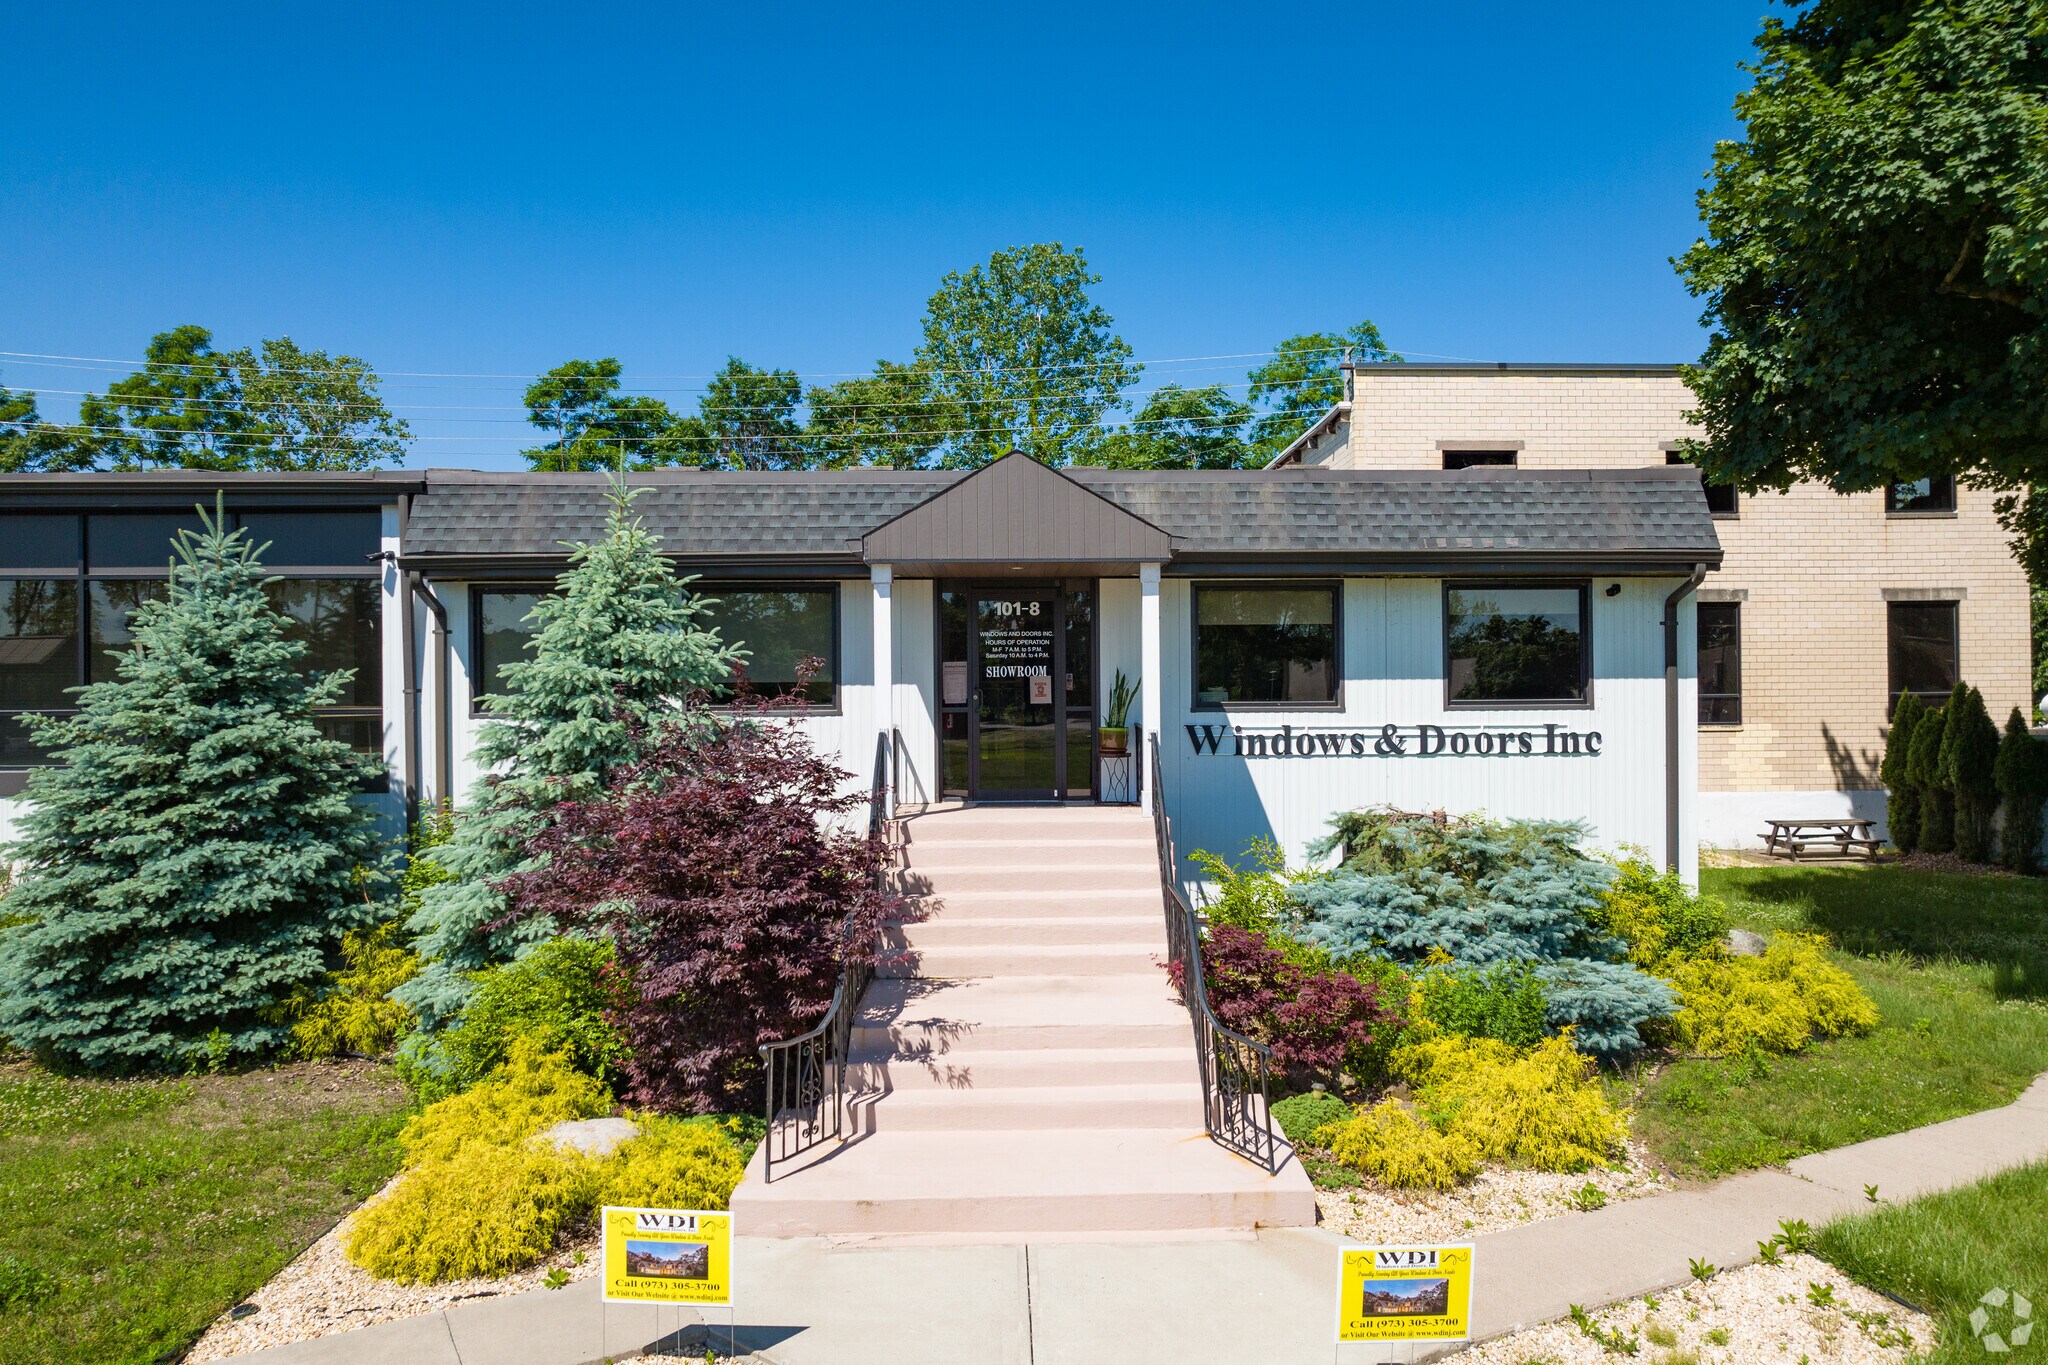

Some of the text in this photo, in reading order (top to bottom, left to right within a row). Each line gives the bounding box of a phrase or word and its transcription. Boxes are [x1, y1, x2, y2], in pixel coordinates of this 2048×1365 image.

[994, 601, 1041, 616] 101-8
[986, 666, 1048, 678] SHOWROOM
[1183, 723, 1602, 757] Windows & Doors Inc
[639, 1214, 696, 1228] WDI
[1378, 1251, 1437, 1265] WDI
[615, 1279, 720, 1291] Call (973) 305-3700
[1350, 1318, 1458, 1329] Call (973) 305-3700
